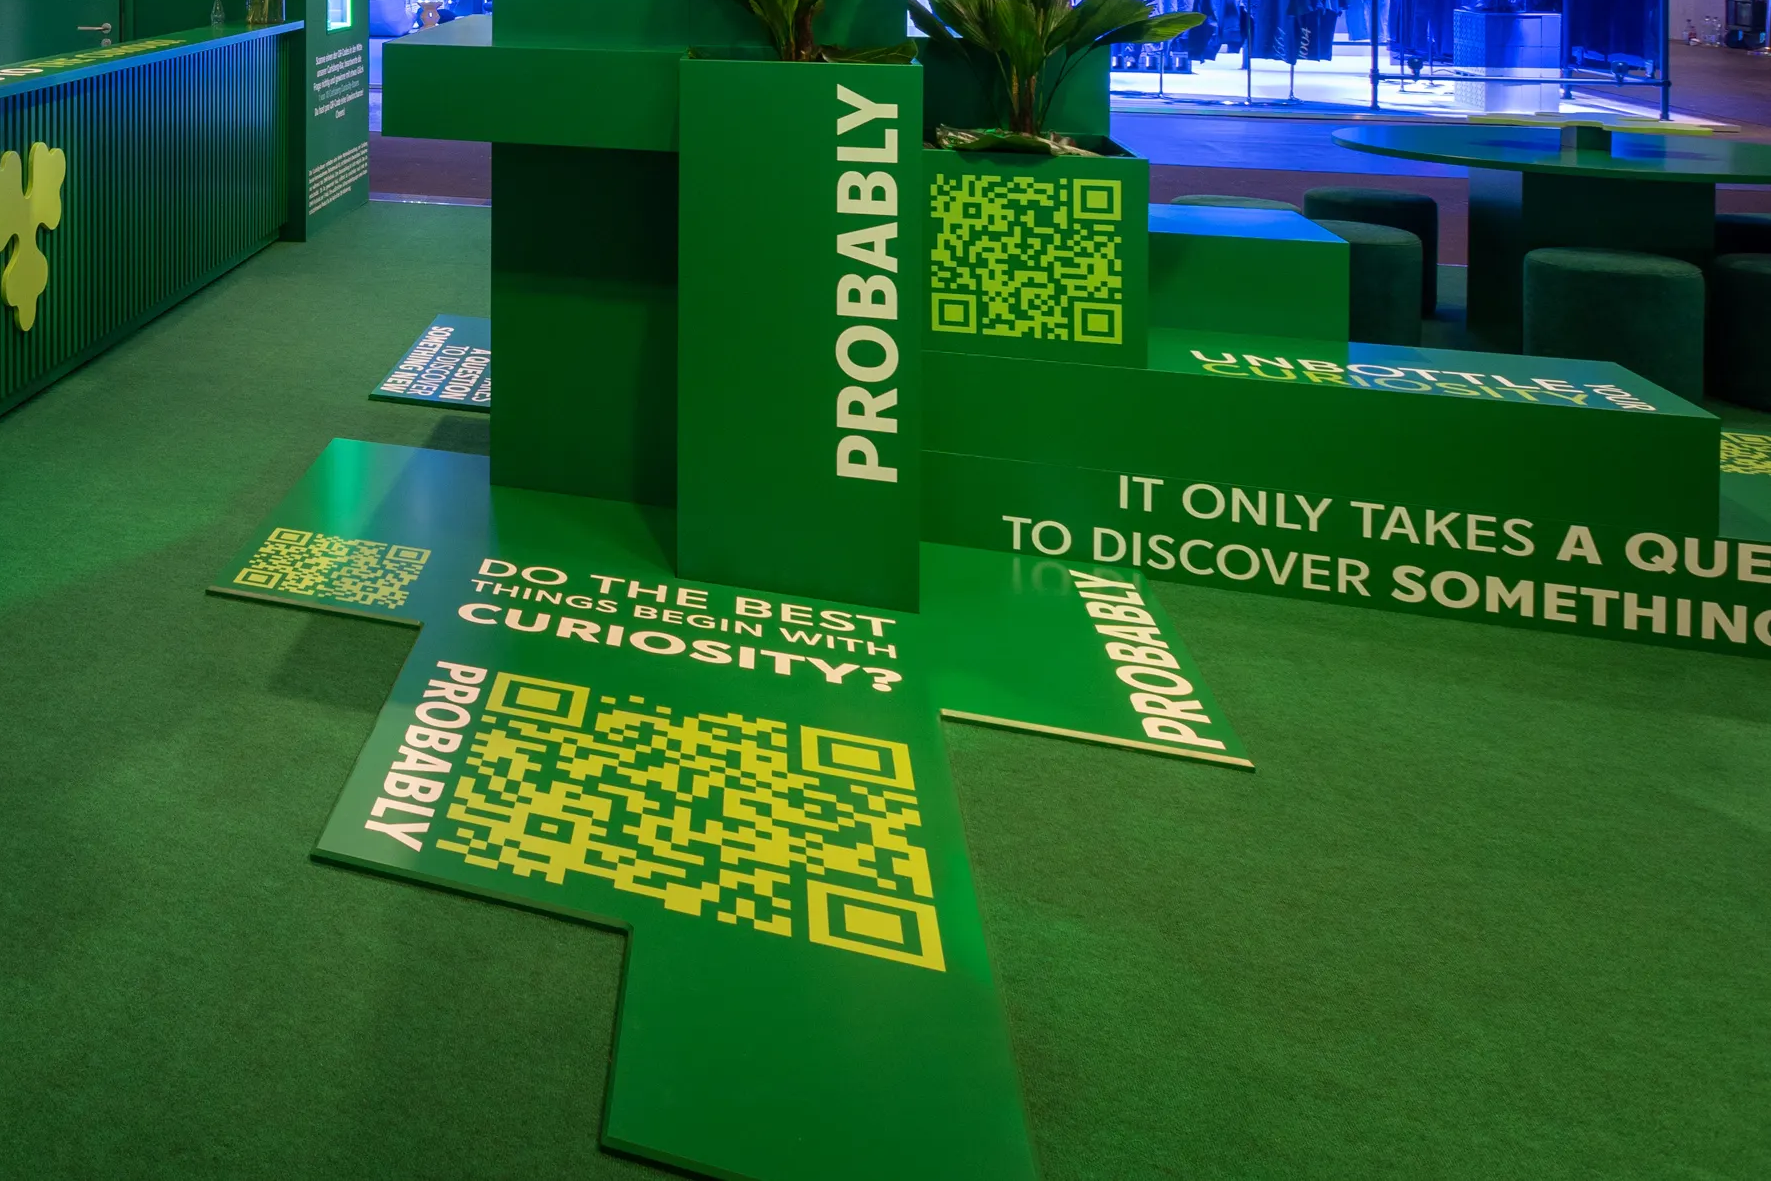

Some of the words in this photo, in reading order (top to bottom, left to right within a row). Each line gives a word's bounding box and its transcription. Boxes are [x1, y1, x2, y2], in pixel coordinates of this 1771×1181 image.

[835, 83, 899, 484] PROBABLY
[399, 326, 454, 371] SOMETHING
[406, 356, 461, 396] DISCOVER
[439, 356, 490, 400] QUESTION
[442, 345, 470, 356] TO
[1189, 349, 1576, 393] UNBOTTLE
[380, 371, 418, 394] NEW
[1201, 362, 1589, 406] CURIOSITY
[1584, 383, 1657, 412] YOUR
[1002, 514, 1072, 556] TO
[1092, 526, 1371, 597] DISCOVER
[1118, 474, 1164, 512] IT
[1182, 483, 1333, 534] ONLY
[1350, 500, 1536, 557] TAKES
[1556, 526, 1604, 565] A
[1625, 531, 1771, 585] QUE
[471, 578, 618, 614] THINGS
[633, 604, 763, 637] BEGIN
[778, 627, 898, 659] WITH
[479, 558, 568, 586] DO
[590, 573, 708, 610] THE
[735, 596, 897, 637] BEST
[458, 603, 903, 692] CURIOSITY?
[1068, 568, 1227, 751] PROBABLY
[364, 660, 489, 852] PROBABLY
